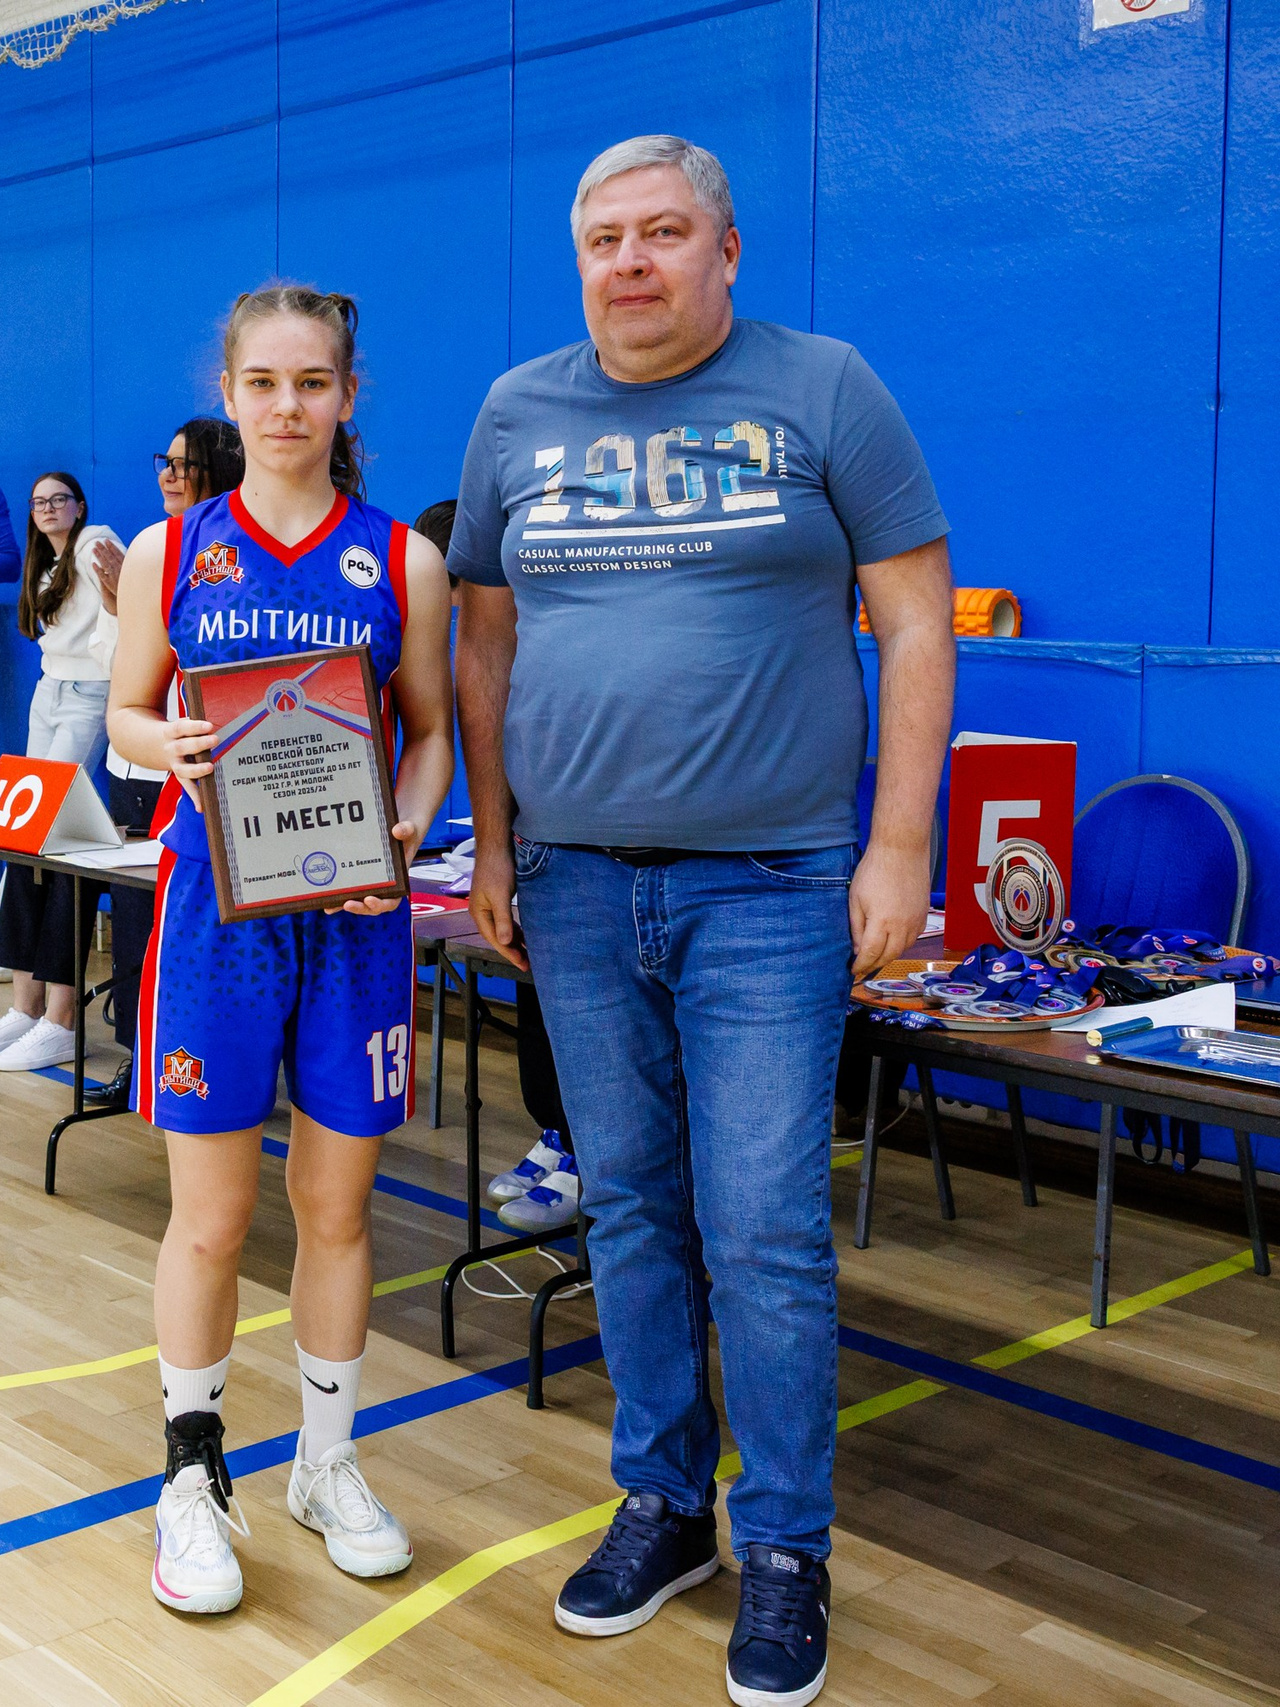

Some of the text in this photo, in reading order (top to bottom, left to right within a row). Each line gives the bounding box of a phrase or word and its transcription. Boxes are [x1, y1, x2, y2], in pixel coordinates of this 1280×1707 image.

[526, 420, 780, 524] 1962
[518, 541, 713, 559] CASUAL MANUFACTURING CLUB
[521, 560, 673, 574] CLASSIC CUSTOM DESIGN
[197, 608, 372, 648] МЫТИЩИ
[261, 733, 323, 750] ПЕРВЕНСТВО
[238, 742, 350, 766] МОСКОВСКОЙ ОБЛАСТИ
[266, 757, 325, 772] ПО БАСКЕТБОЛУ
[232, 761, 361, 786] СРЕДИ КОМАНД ДЕВУШЕК ДО 15 ЛЕТ
[263, 782, 280, 791] 2012
[294, 779, 300, 787] И
[301, 774, 334, 785] МОЛОЖЕ
[273, 785, 327, 799] СЕЗОН 2025/26
[276, 800, 365, 833] МЕСТО
[973, 800, 1050, 924] 5
[366, 1024, 408, 1103] 13
